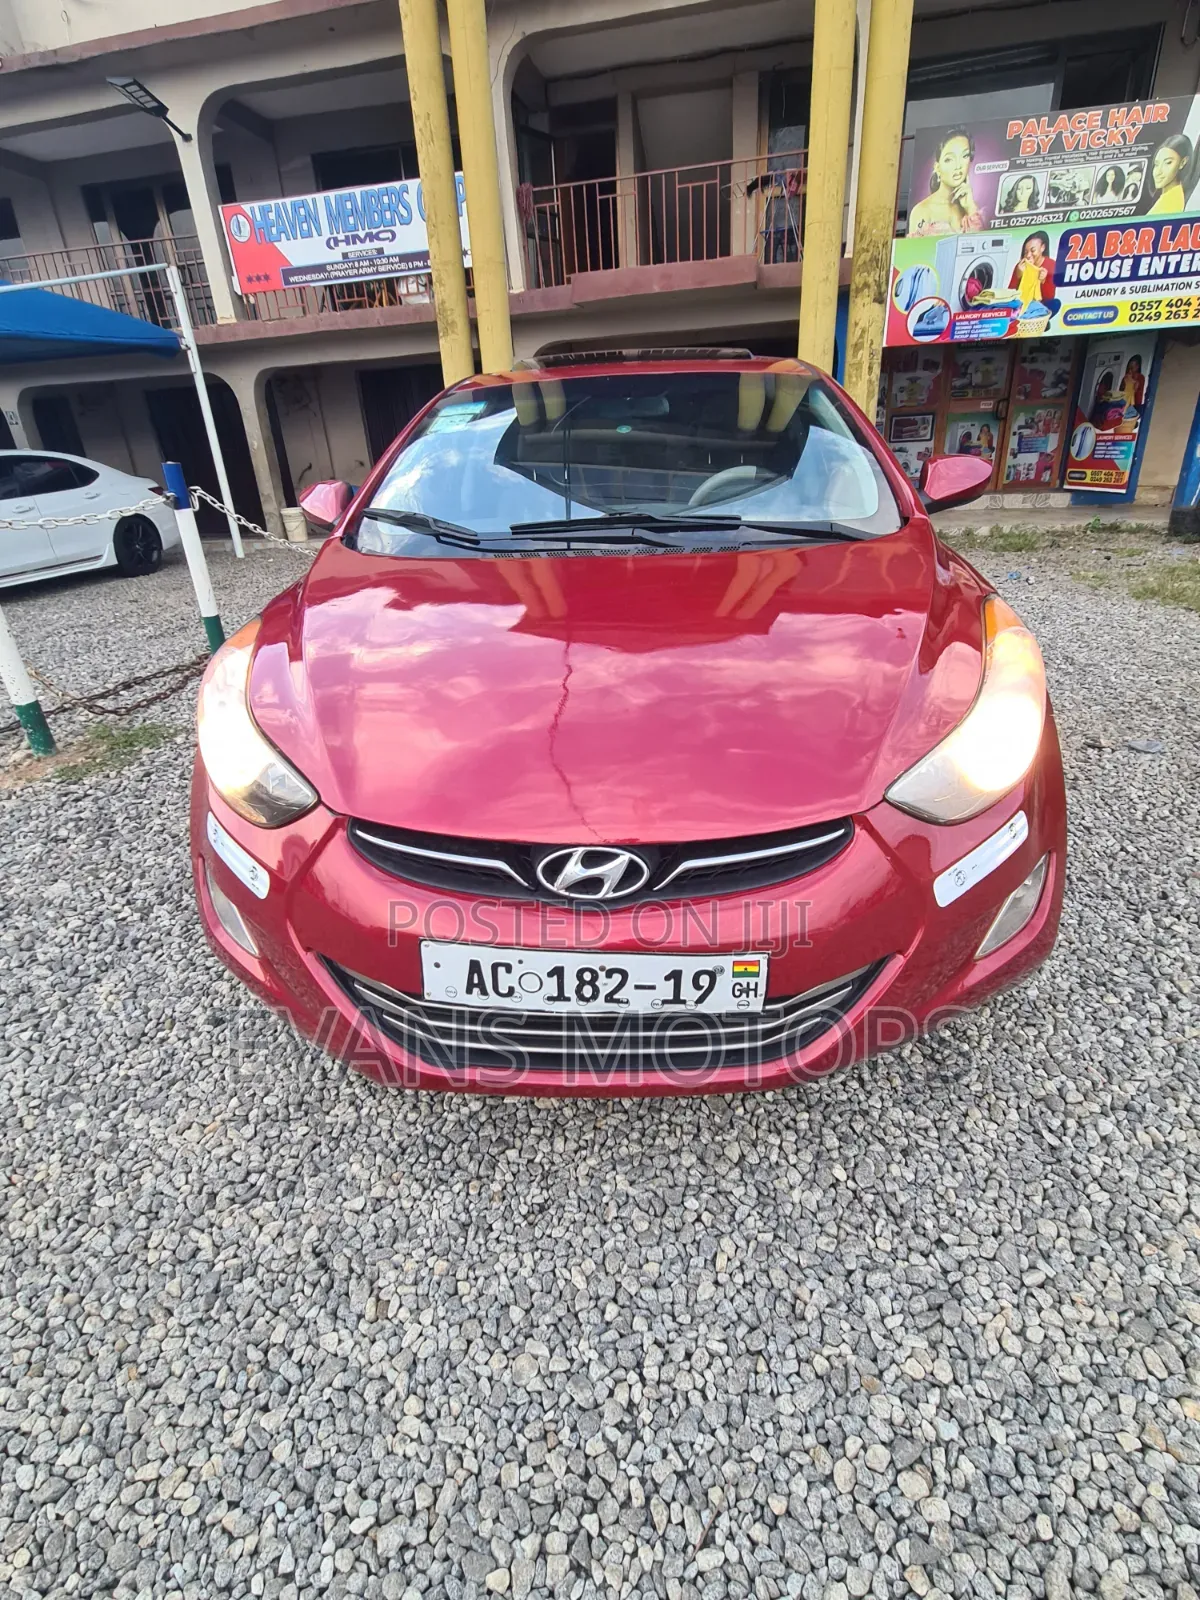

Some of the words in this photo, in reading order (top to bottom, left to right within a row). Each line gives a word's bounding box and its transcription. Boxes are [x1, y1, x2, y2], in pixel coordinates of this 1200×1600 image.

[1006, 109, 1103, 140] PALACE
[1108, 103, 1171, 127] HAIR
[1019, 135, 1060, 156] BY
[1062, 125, 1143, 151] VICKY
[986, 162, 1008, 171] SERVICES
[250, 197, 323, 245] HEAVEN
[324, 184, 413, 234] MEMBERS
[990, 218, 1009, 229] TEL:
[1010, 212, 1064, 226] 0257286323
[1079, 206, 1136, 220] 0202657567
[326, 229, 397, 250] (HMC)
[1065, 232, 1098, 262] 2A
[1102, 227, 1155, 259] B&R
[289, 272, 330, 284] WEDNESDAY:
[358, 266, 377, 276] ARMY
[377, 262, 408, 274] SERVICE)
[412, 259, 423, 268] PM
[326, 261, 354, 272] SUNDAY:
[359, 259, 370, 267] AM
[389, 255, 400, 264] AM
[1064, 258, 1134, 283] HOUSE
[1075, 287, 1119, 299] LAUNDRY
[1120, 286, 1127, 295] &
[1128, 281, 1193, 295] SUBLIMATION
[982, 310, 1007, 318] SERVICES
[1067, 311, 1103, 321] CONTACT
[1103, 310, 1114, 319] US
[1130, 300, 1163, 312] 0557
[1165, 298, 1192, 309] 404
[1128, 311, 1162, 323] 0249
[1165, 309, 1190, 321] 263
[465, 959, 516, 998] AC
[546, 965, 718, 1005] 182-19
[732, 981, 759, 999] GH
